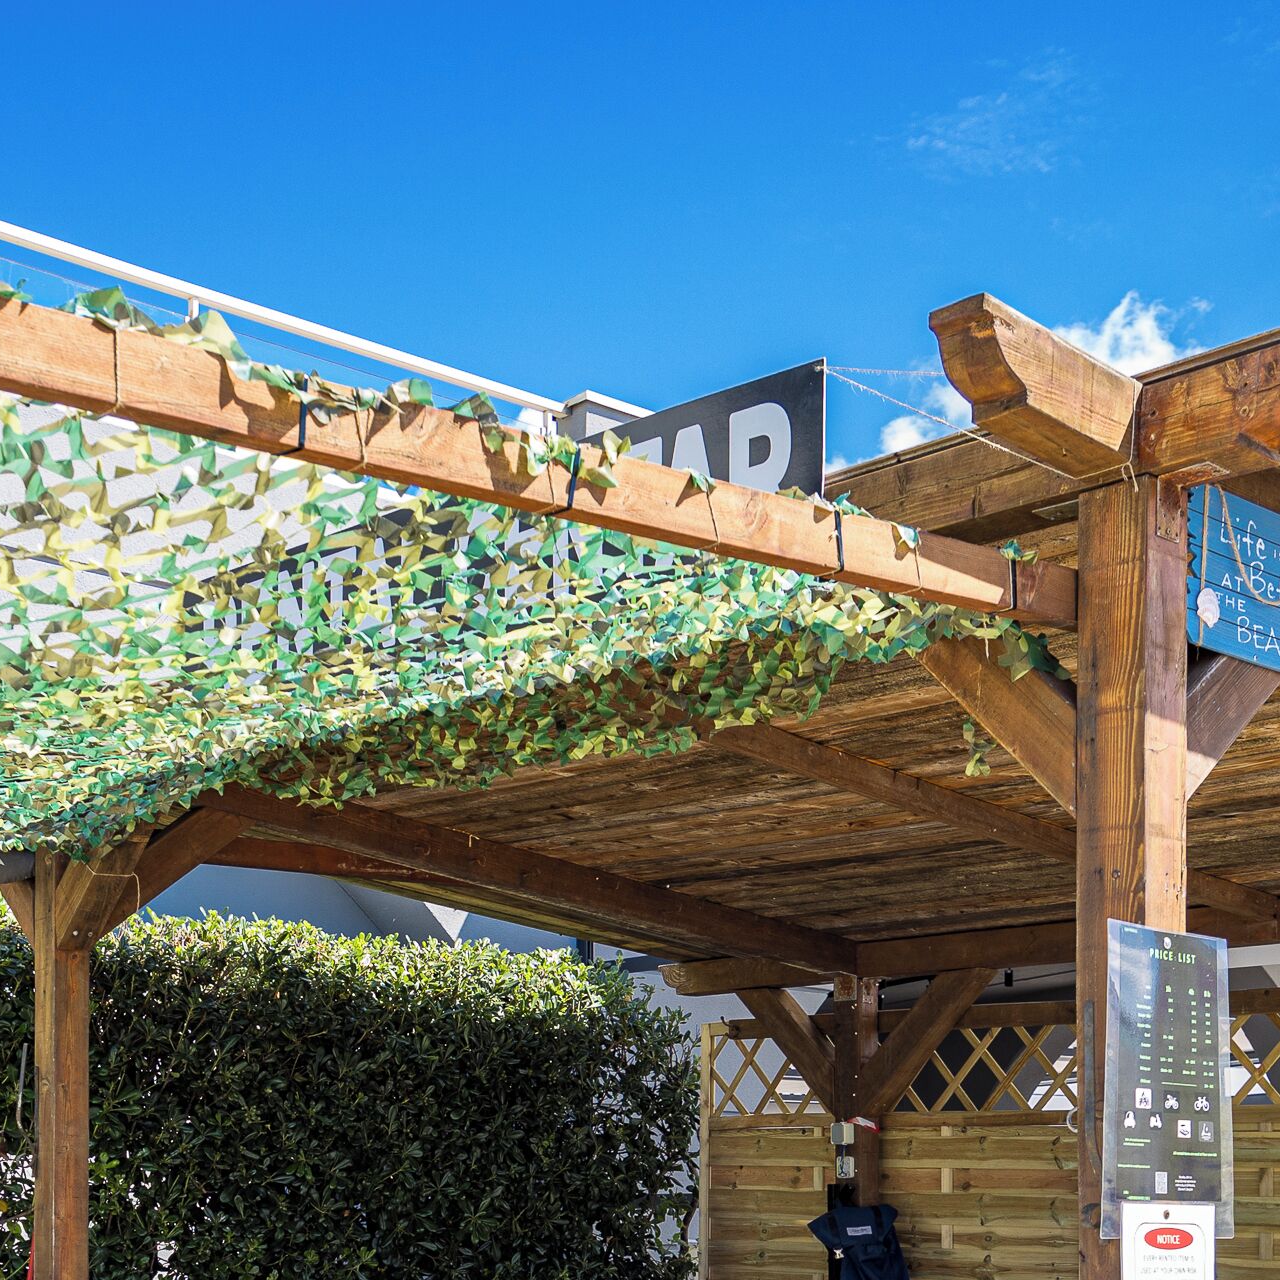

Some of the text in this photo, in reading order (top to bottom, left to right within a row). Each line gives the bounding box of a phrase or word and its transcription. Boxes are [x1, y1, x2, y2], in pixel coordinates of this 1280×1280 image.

[1221, 574, 1244, 592] AT
[1215, 592, 1247, 613] THE
[1149, 948, 1197, 965] PRICE LIST
[1156, 1234, 1181, 1245] NOTICE
